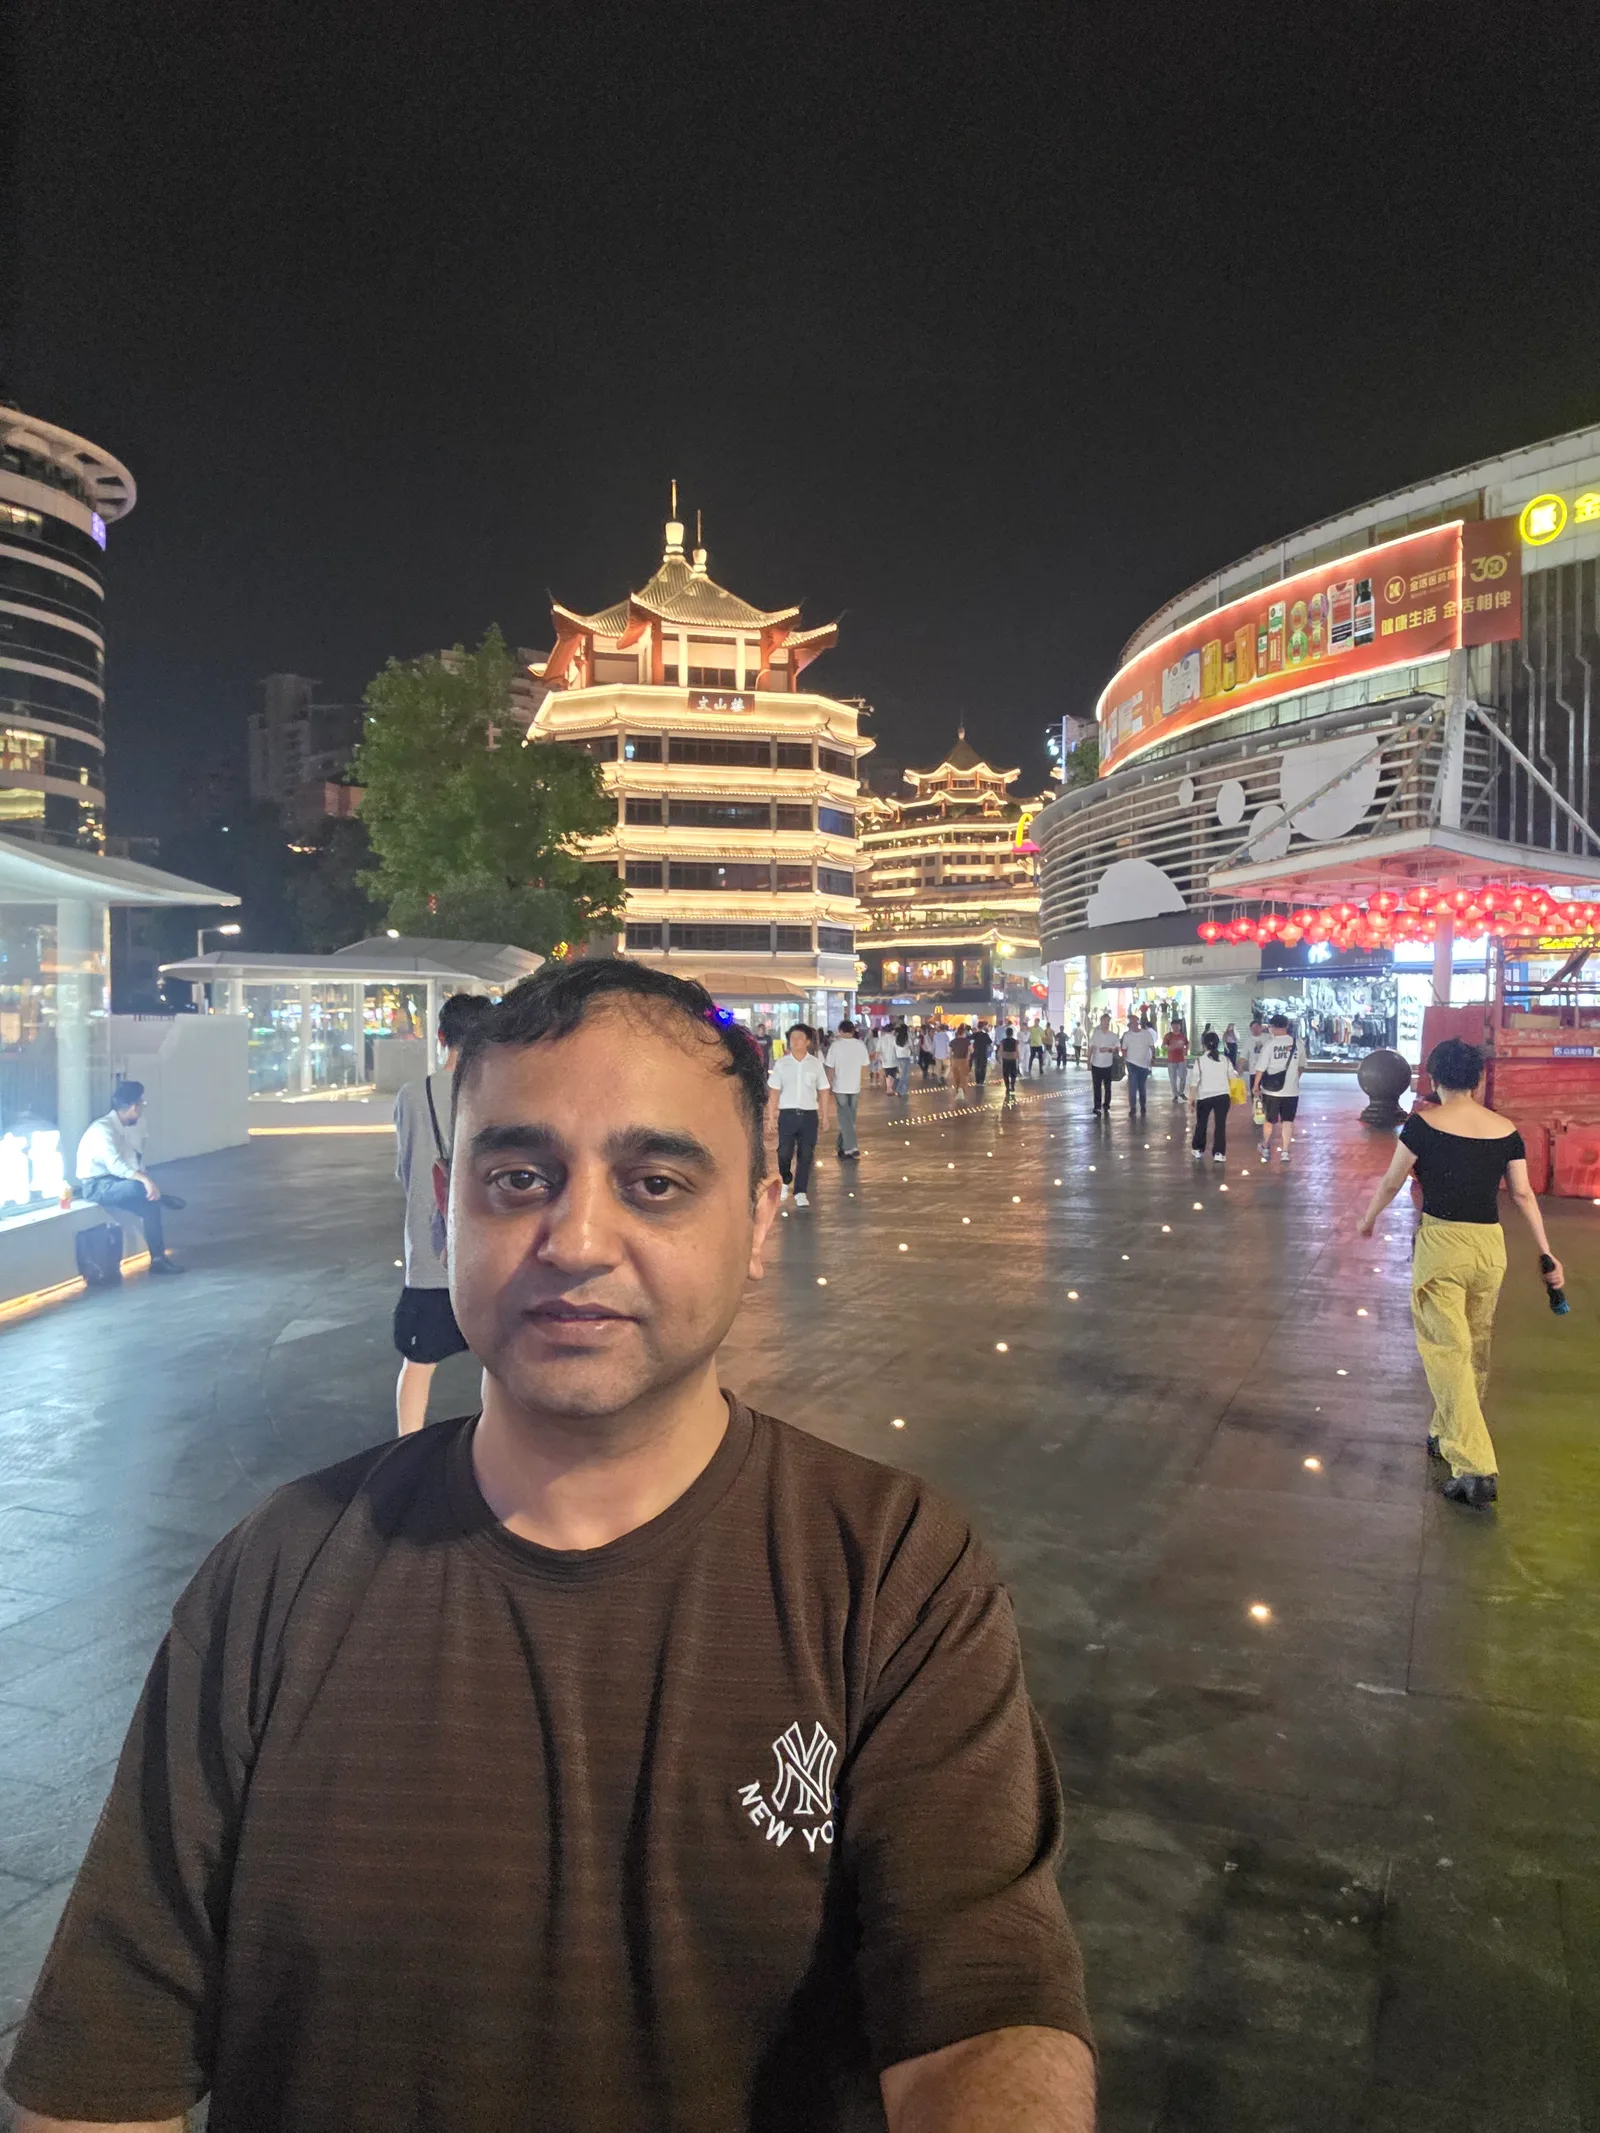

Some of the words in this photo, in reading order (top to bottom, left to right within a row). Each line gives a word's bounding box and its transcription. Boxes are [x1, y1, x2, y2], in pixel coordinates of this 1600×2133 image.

[1381, 606, 1437, 637] 健康生活
[738, 1779, 794, 1848] NEW
